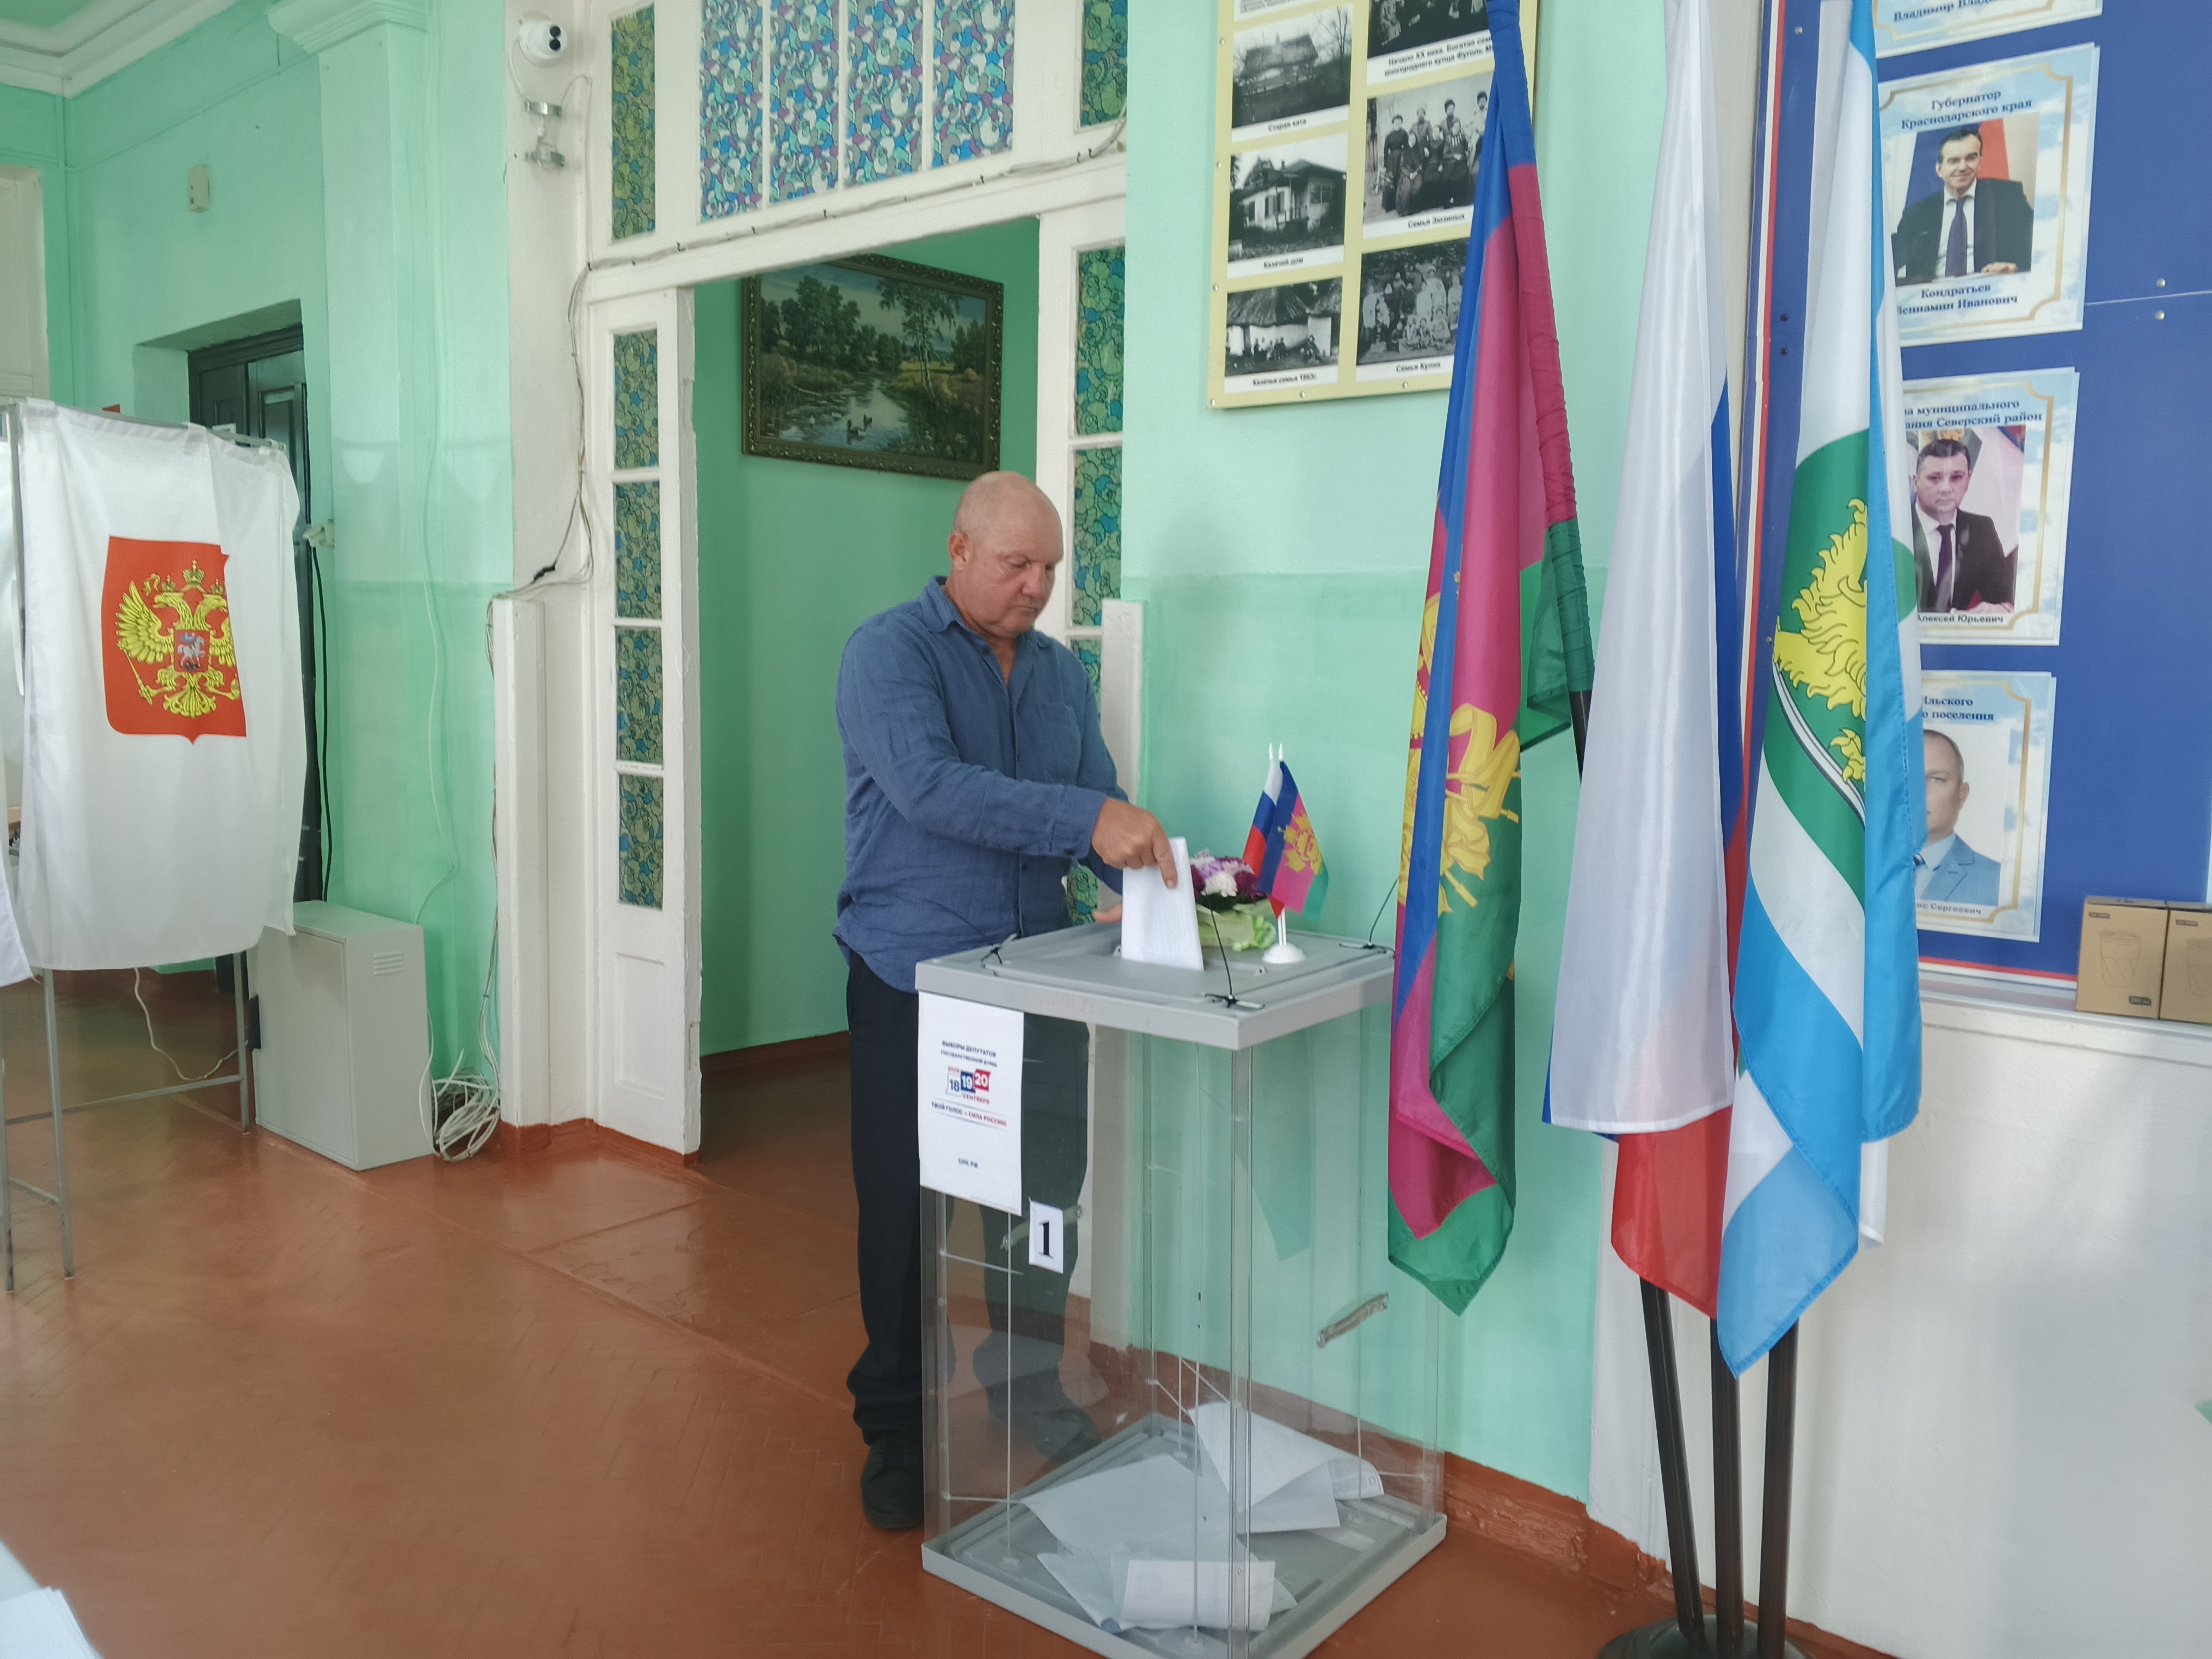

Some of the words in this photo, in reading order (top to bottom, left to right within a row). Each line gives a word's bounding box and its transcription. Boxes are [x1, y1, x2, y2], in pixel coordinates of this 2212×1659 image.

[1894, 4, 1954, 22] Владимир
[1388, 55, 1414, 66] Начало
[1447, 40, 1475, 52] Богатая
[1434, 56, 1455, 66] купца
[1932, 91, 2001, 111] Губернатор
[1901, 106, 1998, 130] Краснодарского
[2002, 100, 2032, 112] края
[1268, 123, 1291, 132] Старая
[1408, 219, 1430, 229] Семья
[1264, 259, 1289, 269] Казачий
[1291, 257, 1304, 266] дом
[1921, 284, 1991, 299] Кондратьев
[1958, 296, 2018, 309] Иванович
[1396, 364, 1418, 373] Семья
[1253, 378, 1277, 386] Казачья
[1279, 375, 1298, 384] семья
[1917, 401, 2019, 416] муниципального
[1937, 414, 2000, 428] Северский
[2005, 412, 2042, 425] район
[1958, 614, 2004, 625] Юрьевич
[1932, 711, 1994, 721] поселения
[1931, 903, 1981, 914] Сергеевич
[966, 1045, 997, 1058] ДЕПУТАТОВ
[949, 1079, 960, 1092] 18
[962, 1075, 973, 1089] 19
[974, 1073, 988, 1087] 20
[931, 1101, 945, 1110] ТВОЙ
[946, 1105, 963, 1115] ГОЛОС
[968, 1111, 982, 1120] СИЛА
[1039, 1220, 1054, 1259] 1
